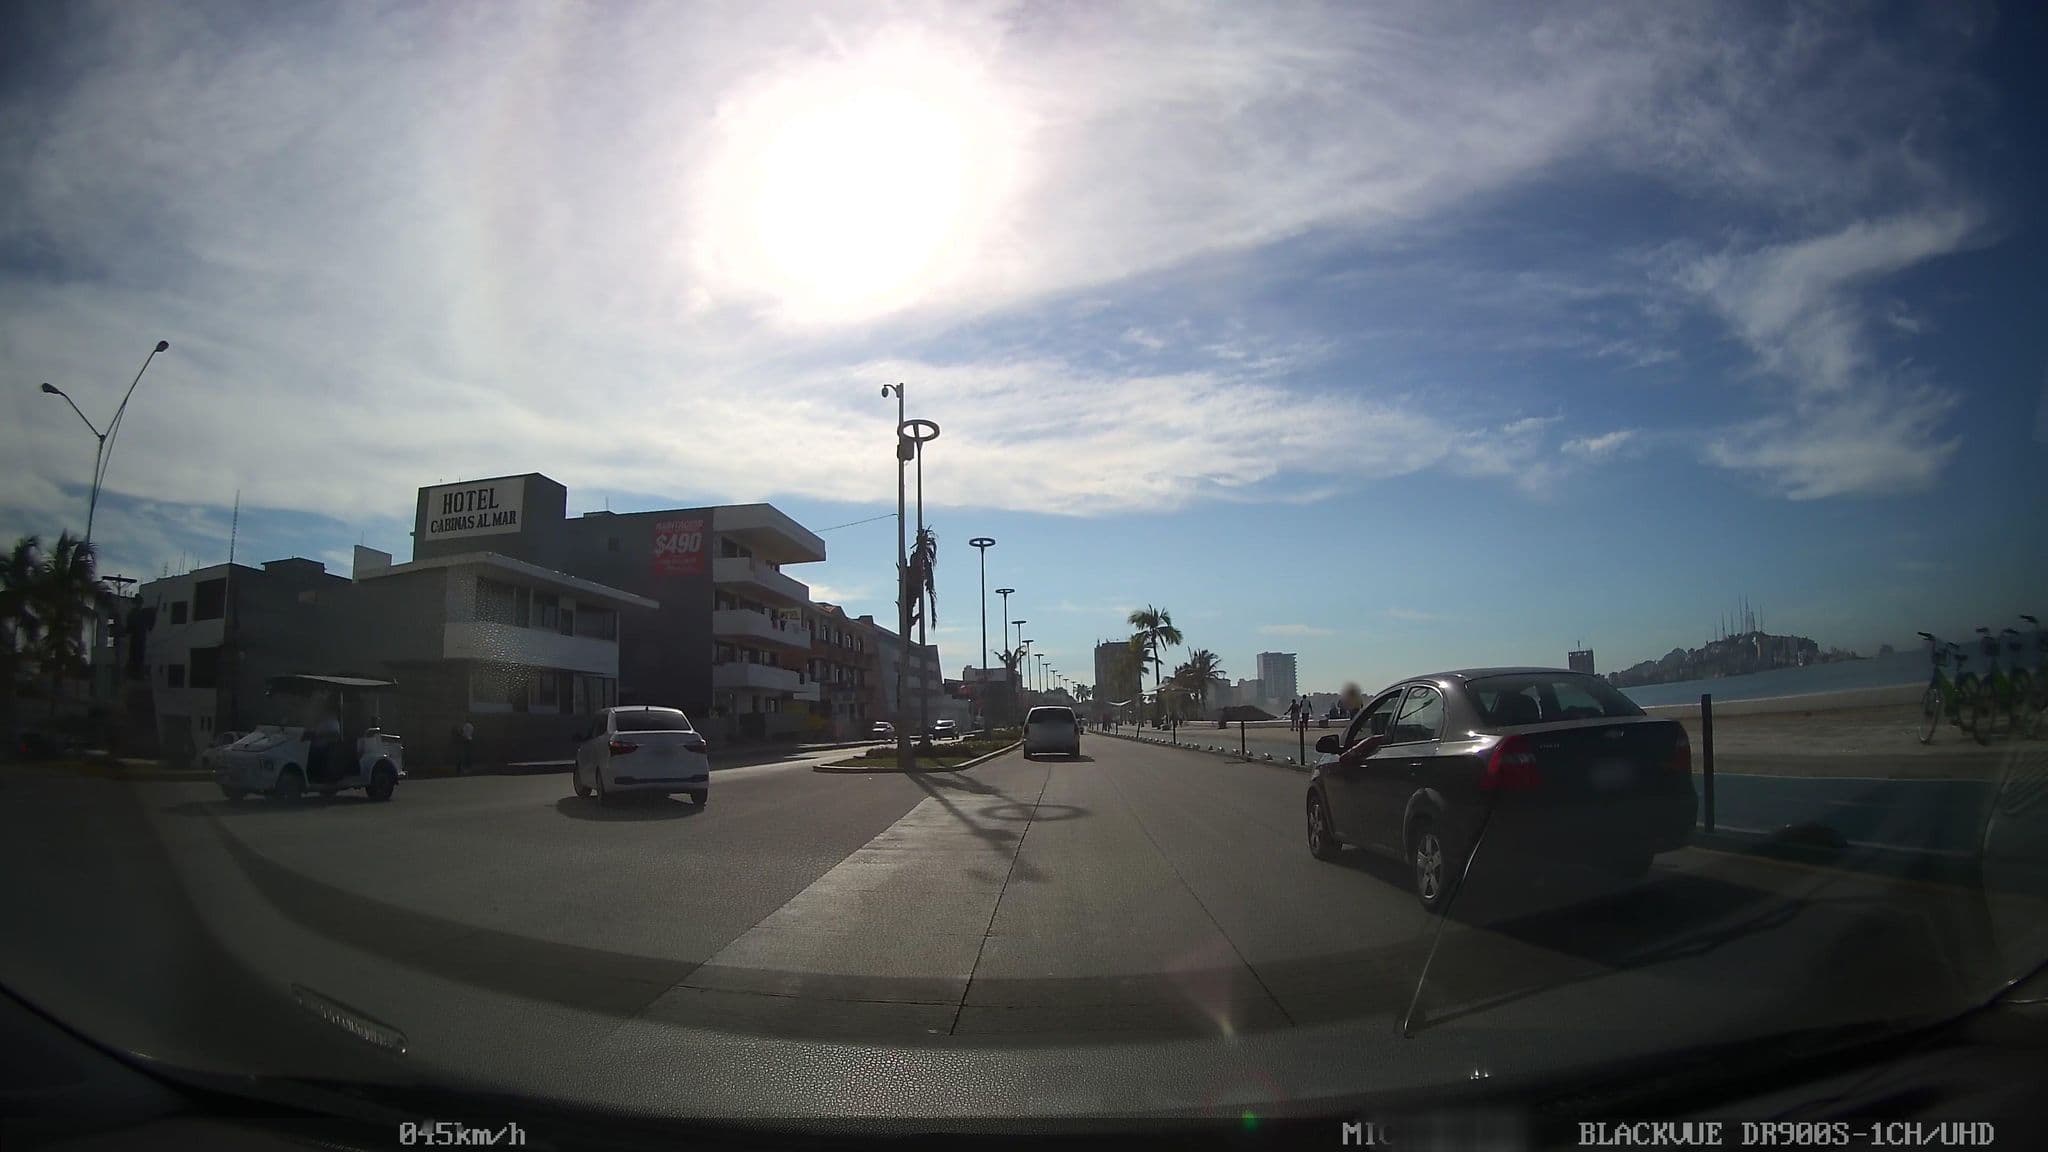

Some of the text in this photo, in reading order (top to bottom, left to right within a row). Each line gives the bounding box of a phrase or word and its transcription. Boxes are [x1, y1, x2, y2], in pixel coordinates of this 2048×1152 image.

[443, 488, 499, 515] HOTEL
[431, 511, 517, 534] CABINAS AL MAR
[655, 532, 703, 555] $490
